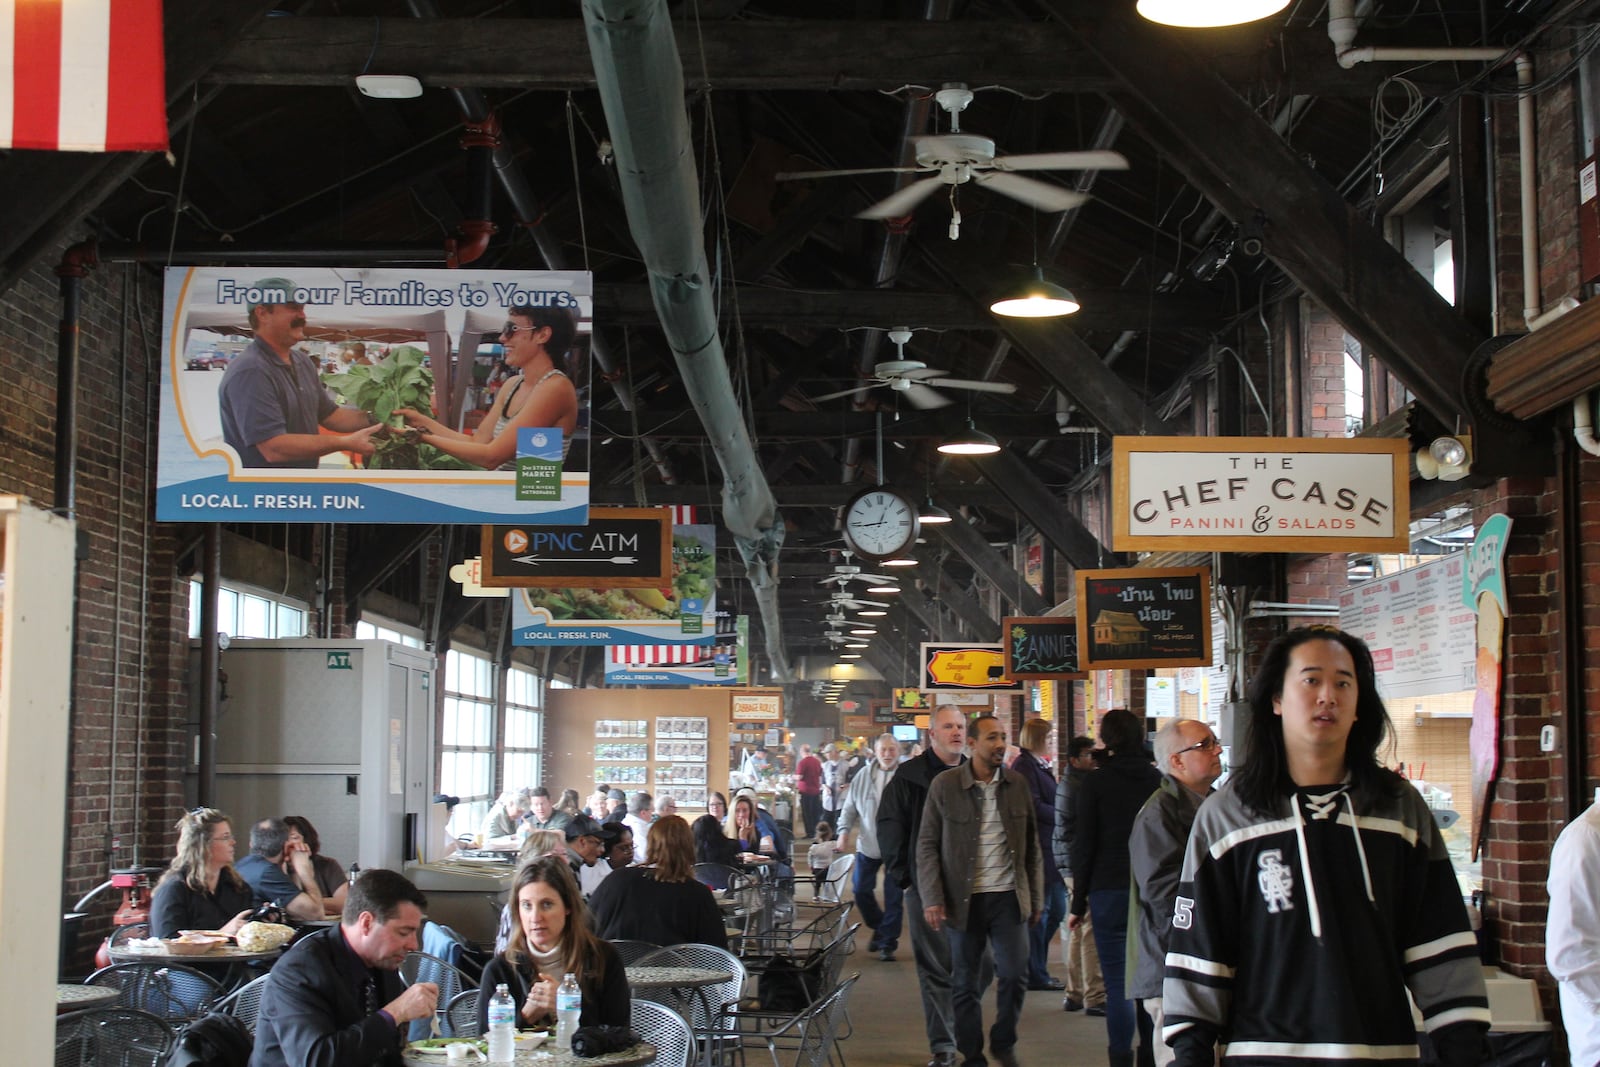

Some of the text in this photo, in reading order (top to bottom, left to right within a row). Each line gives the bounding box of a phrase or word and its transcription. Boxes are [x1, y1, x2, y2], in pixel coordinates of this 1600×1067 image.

[217, 279, 578, 308] From our Families to Yours.
[1229, 457, 1293, 470] THE
[181, 494, 365, 509] LOCAL. FRESH. FUN.
[1133, 477, 1390, 526] CHEF CASE
[1170, 504, 1356, 534] PANINI & SALADS
[532, 532, 638, 551] PNC ATM
[524, 632, 612, 640] LOCAL. FRESH. FUN.
[1172, 895, 1194, 930] 5
